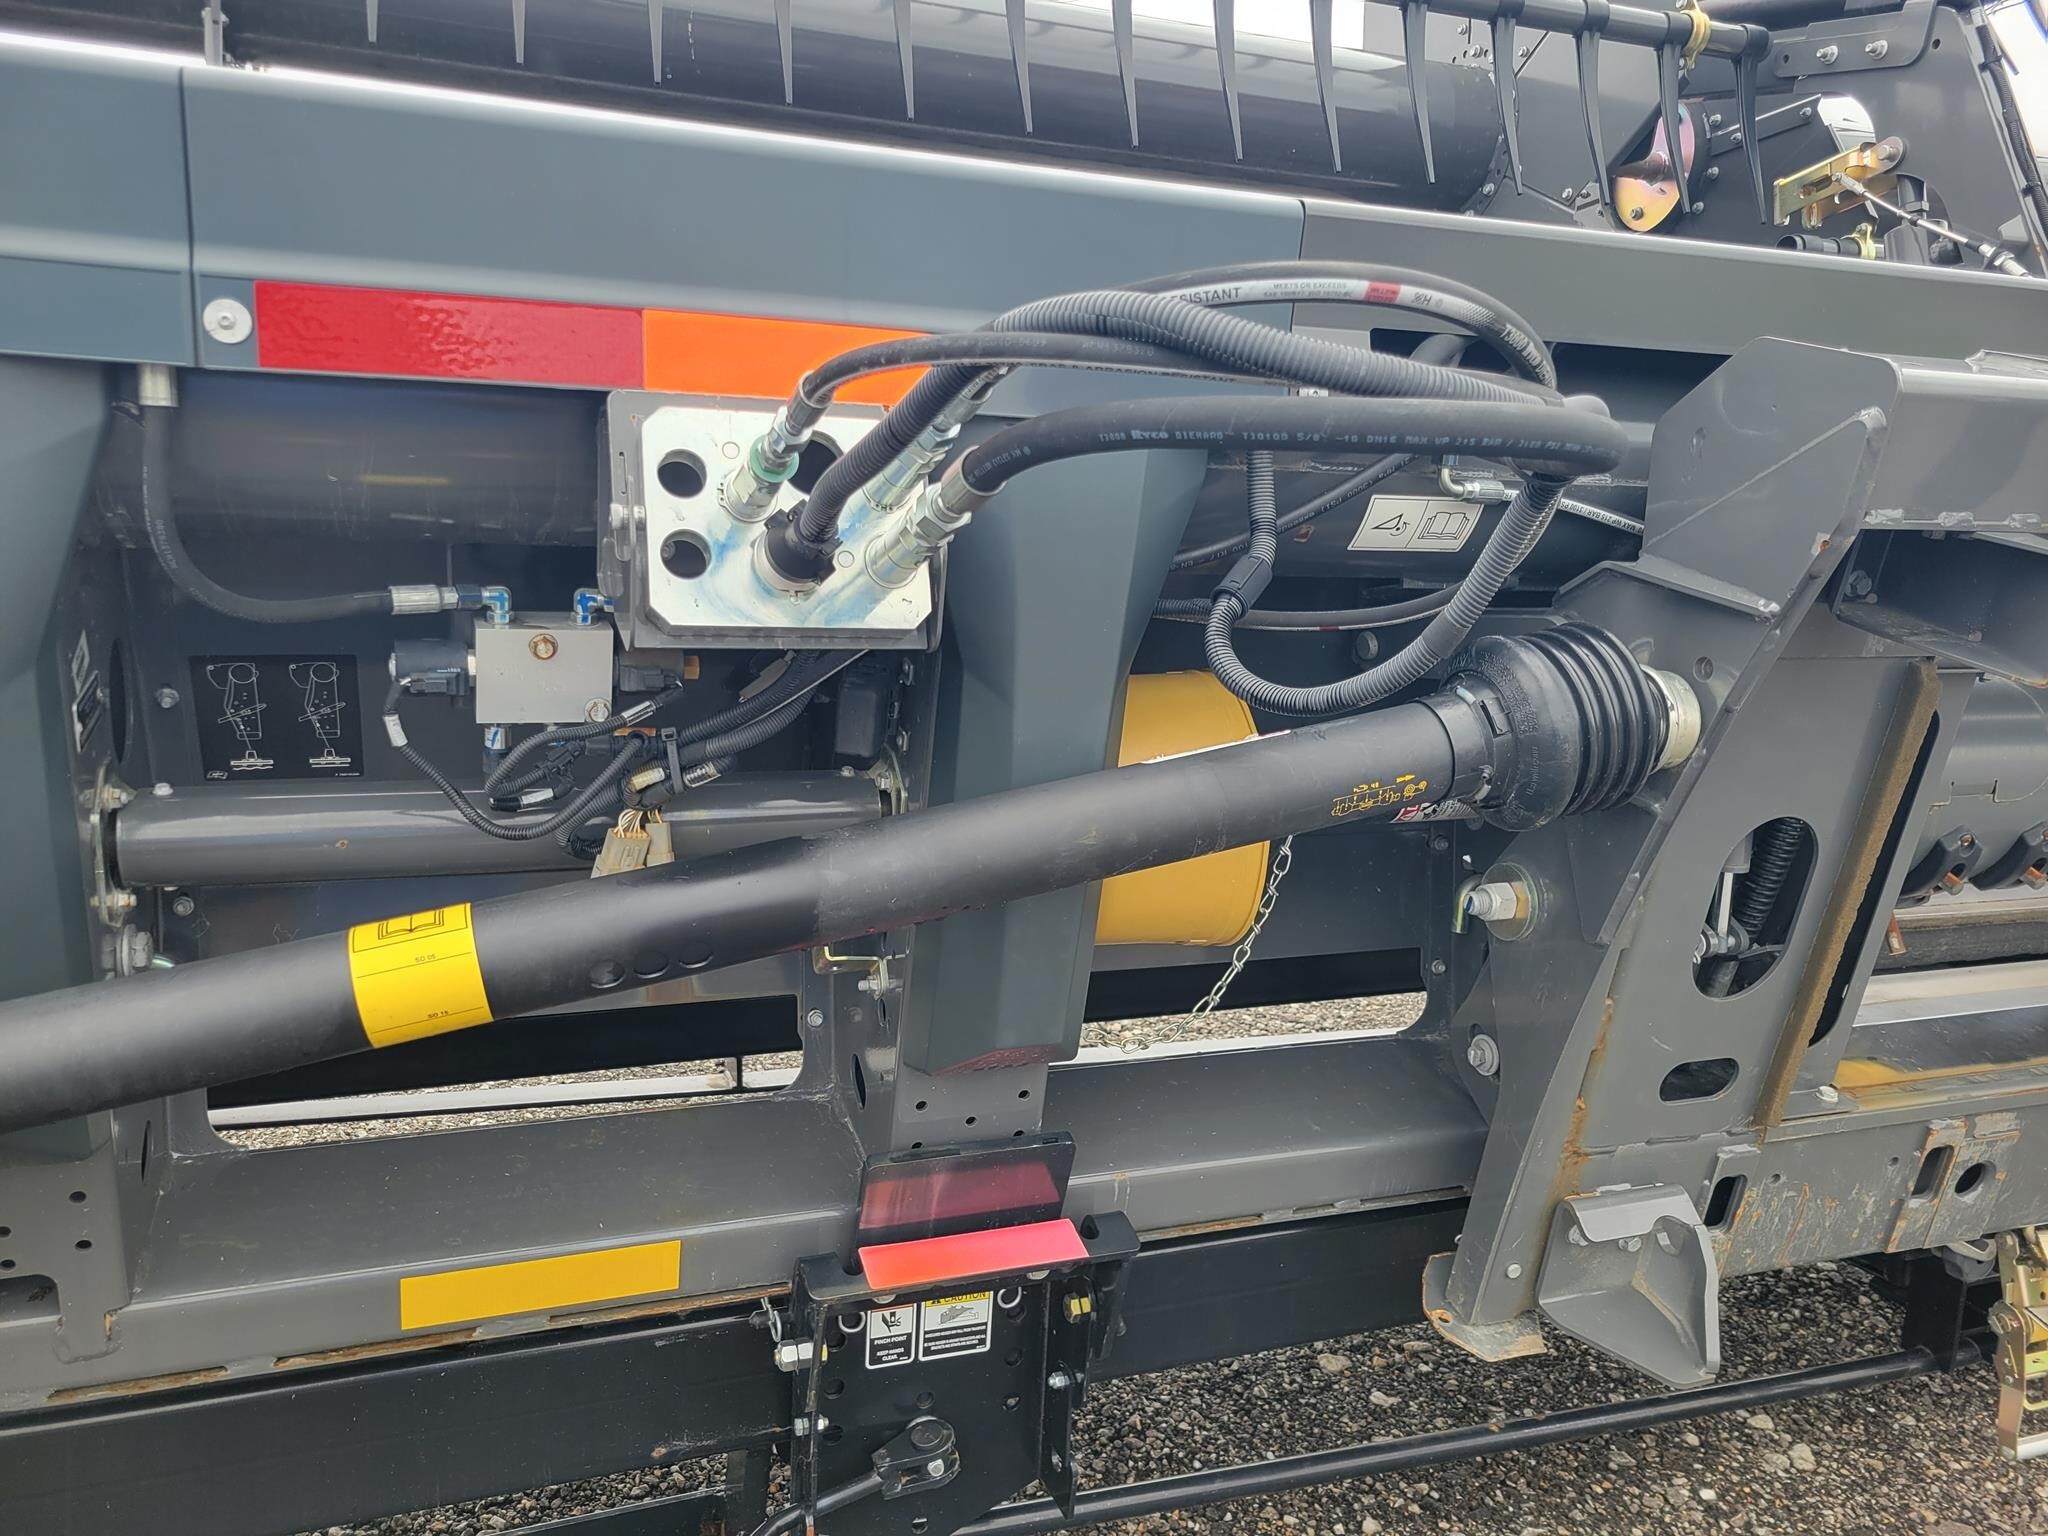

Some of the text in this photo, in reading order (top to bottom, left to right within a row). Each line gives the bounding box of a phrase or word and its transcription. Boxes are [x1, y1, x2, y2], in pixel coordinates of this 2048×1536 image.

[1163, 286, 1242, 304] SISTANT
[1500, 322, 1528, 351] T3000
[1587, 508, 1601, 519] BAR
[1600, 512, 1612, 523] 215
[1622, 519, 1636, 532] MAX
[874, 1335, 908, 1346] PINCH POINT
